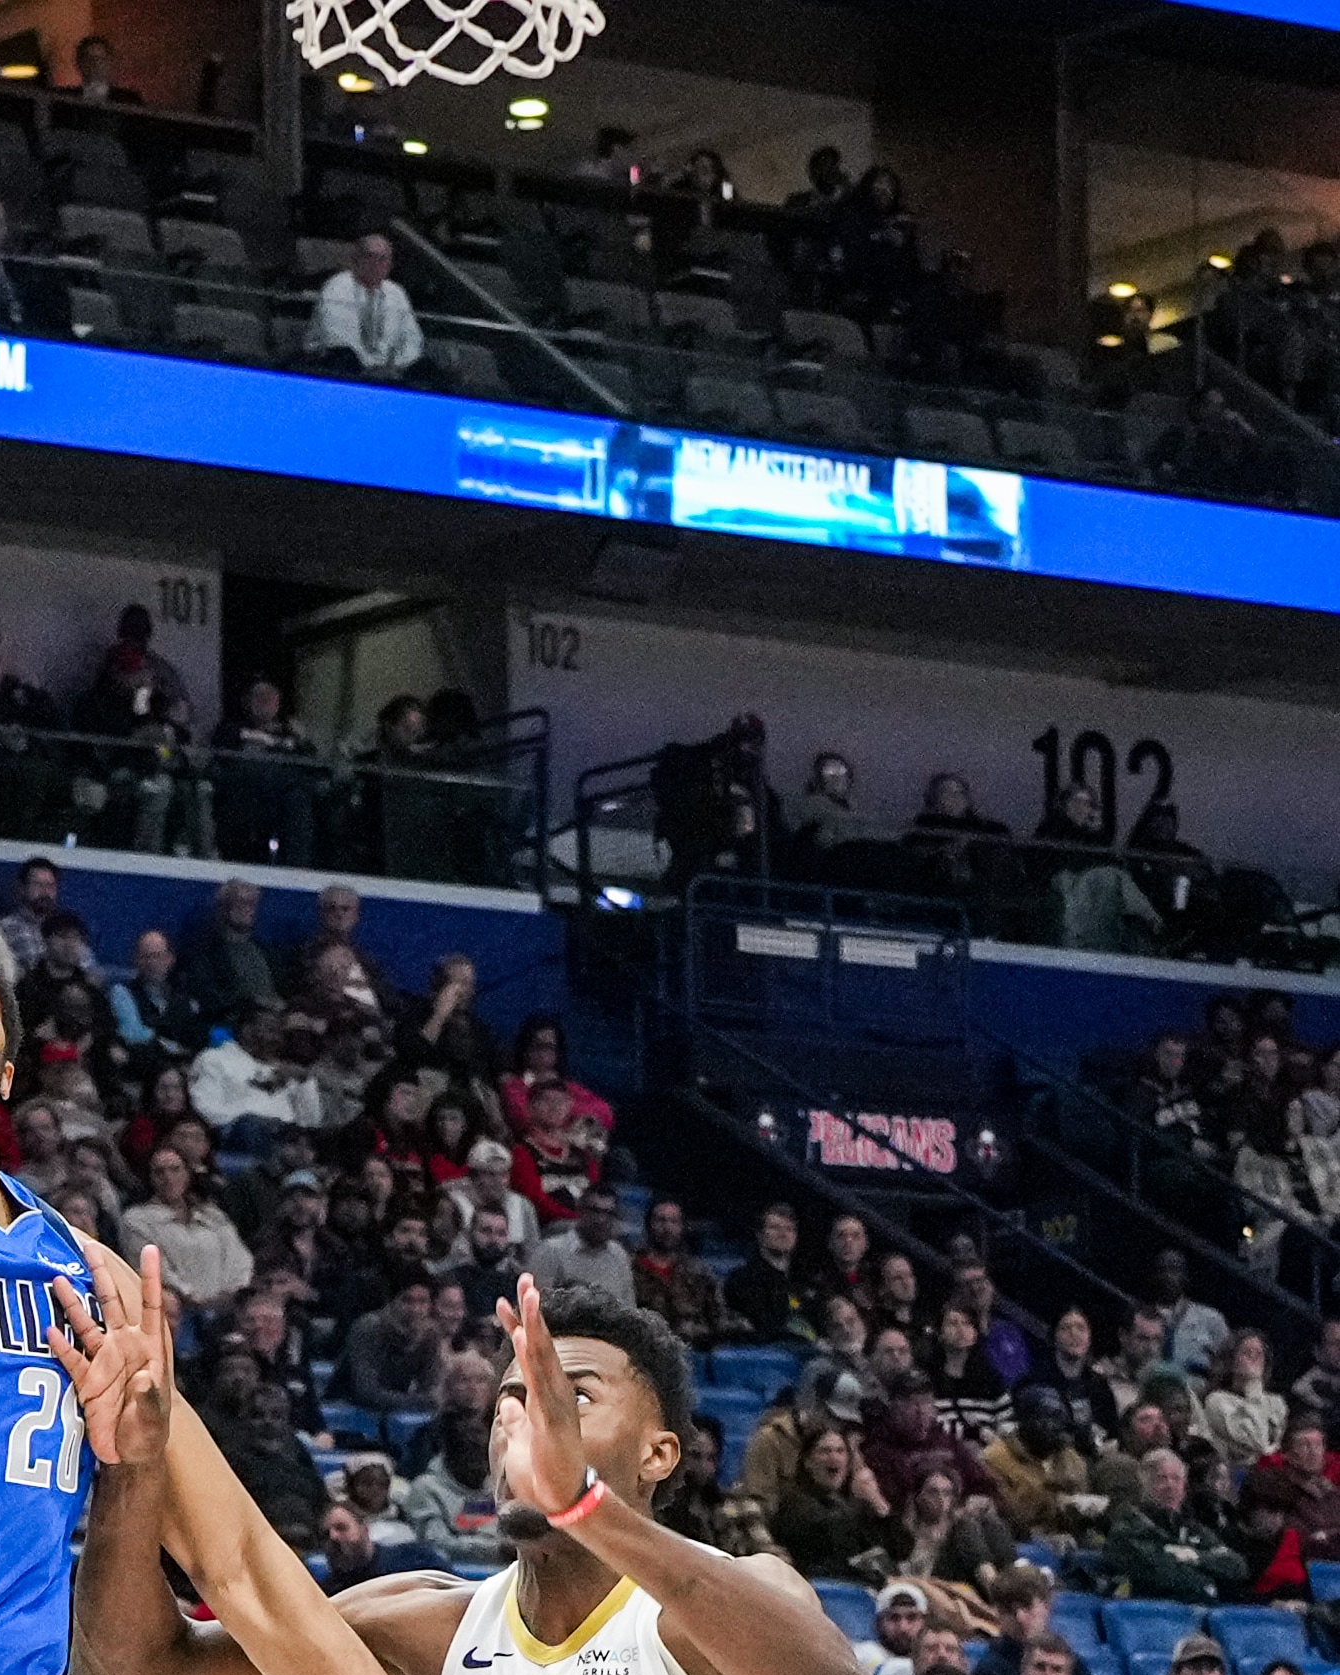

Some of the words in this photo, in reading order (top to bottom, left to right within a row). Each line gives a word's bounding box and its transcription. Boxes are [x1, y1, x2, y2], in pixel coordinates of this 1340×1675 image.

[160, 576, 209, 627] 101
[528, 621, 581, 671] 102
[1031, 725, 1174, 849] 102
